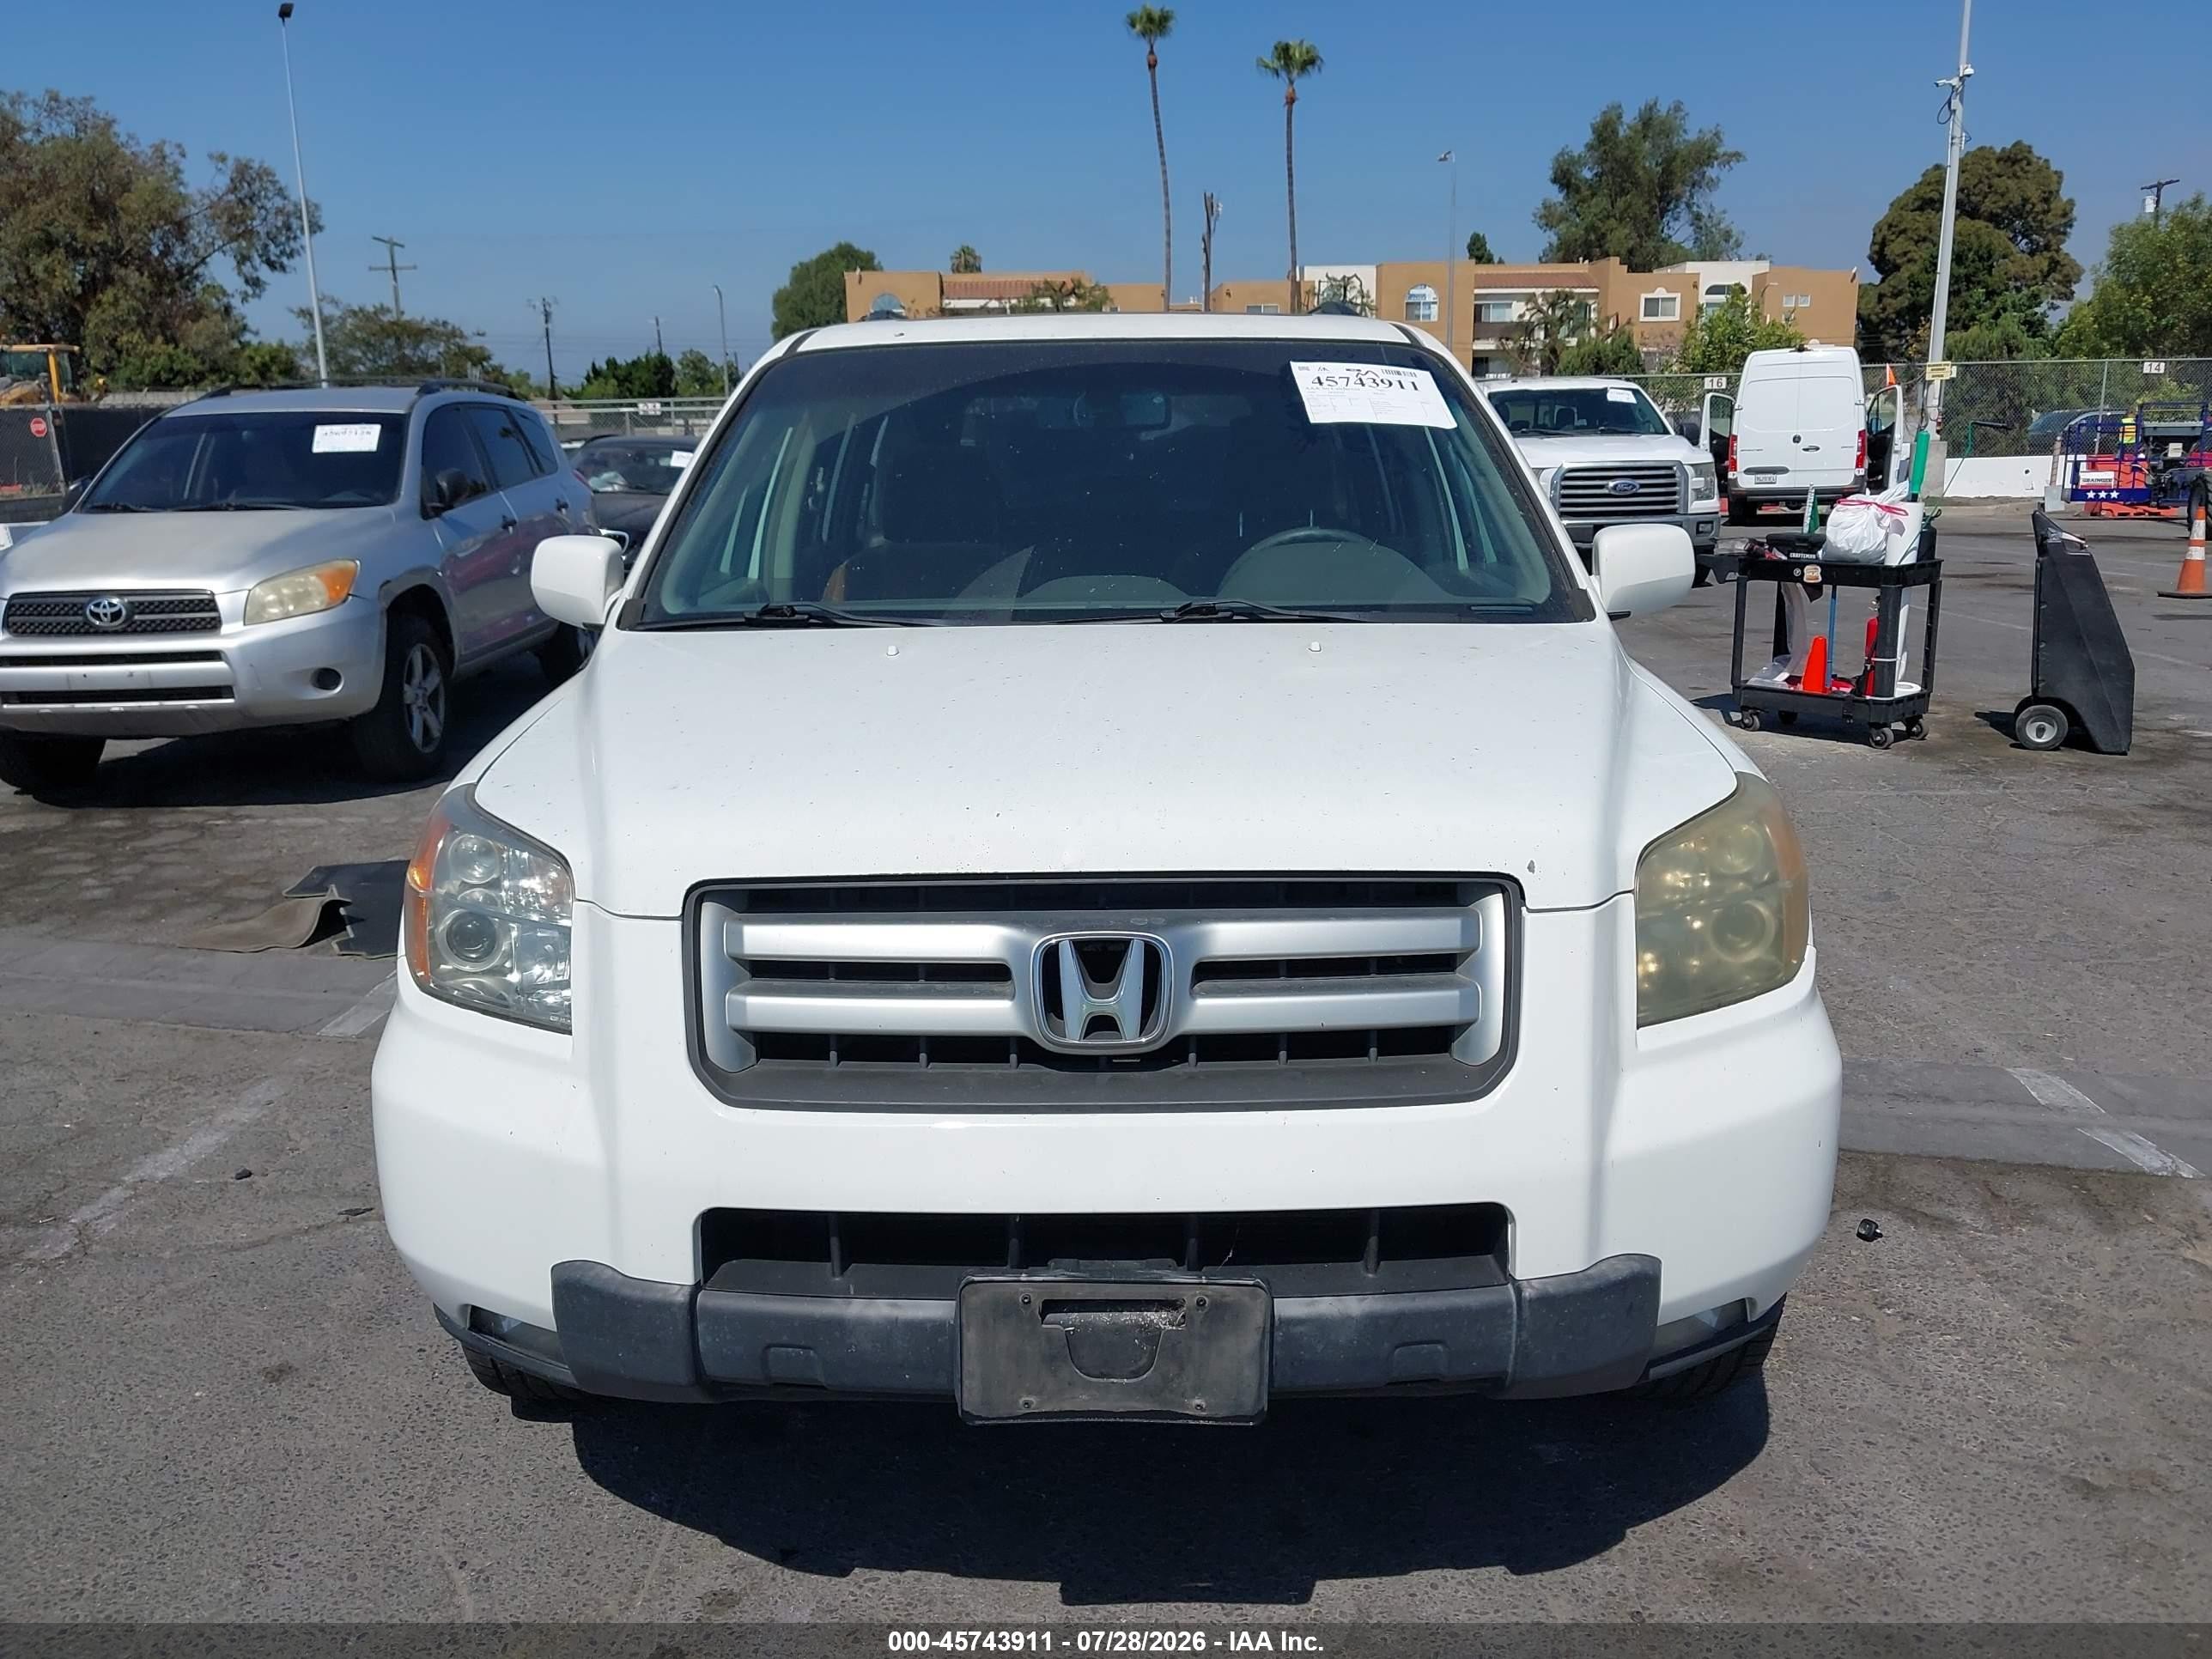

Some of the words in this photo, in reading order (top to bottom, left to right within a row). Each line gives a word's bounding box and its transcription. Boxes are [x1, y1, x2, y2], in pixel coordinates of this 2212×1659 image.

[2148, 362, 2161, 373] 14
[1312, 375, 1419, 391] 45743911
[1709, 378, 1723, 388] 16
